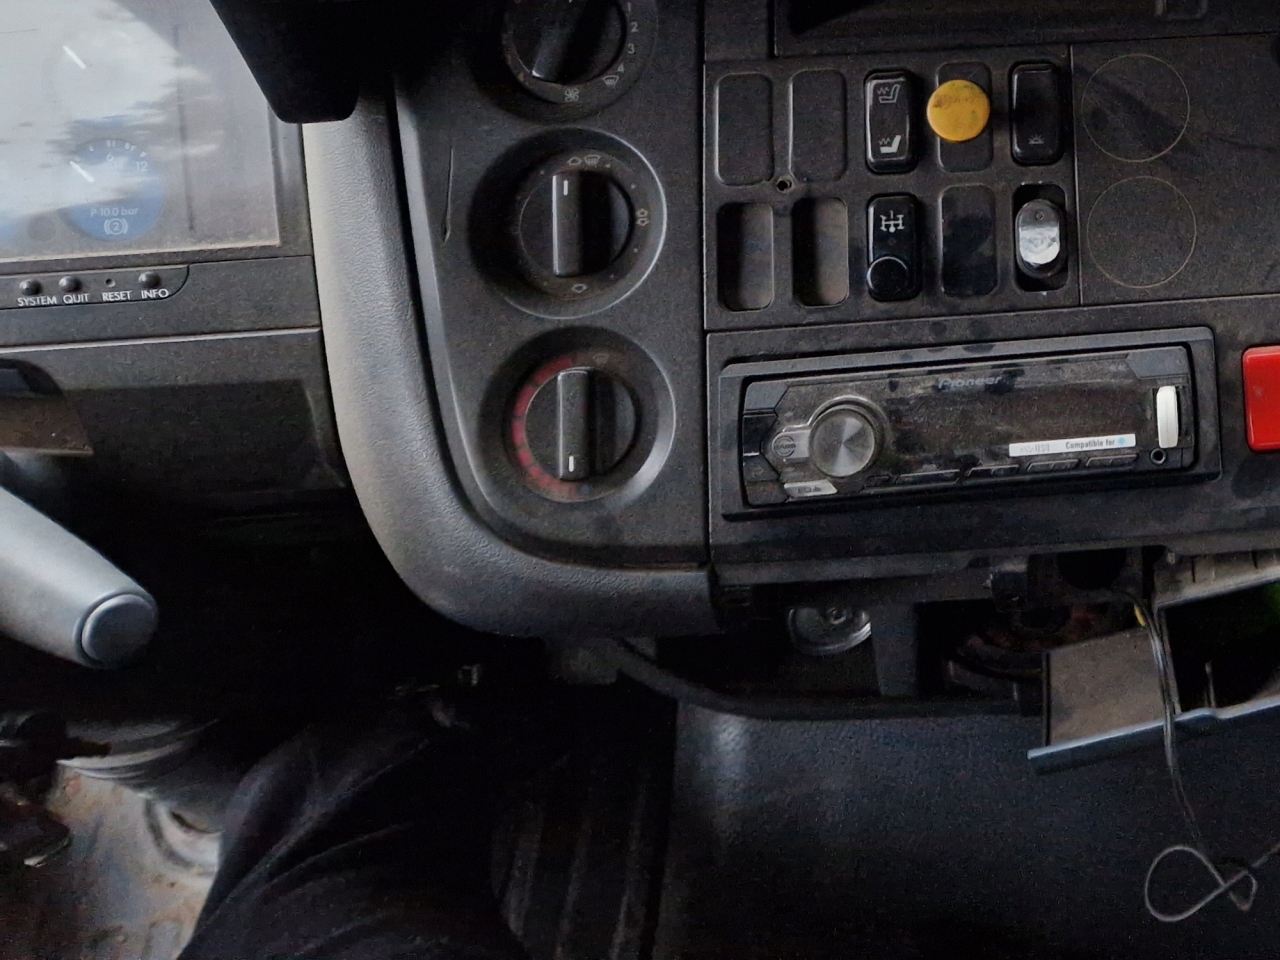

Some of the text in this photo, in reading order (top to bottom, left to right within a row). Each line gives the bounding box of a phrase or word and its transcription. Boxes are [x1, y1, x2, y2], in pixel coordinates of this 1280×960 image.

[630, 21, 639, 33] 2
[627, 43, 636, 55] 3
[136, 161, 148, 172] 12
[121, 206, 139, 216] bar
[17, 288, 170, 307] SYSTEM QUIT RESET INFO
[938, 376, 1002, 389] Pioneer
[1065, 438, 1115, 450] Compatible for
